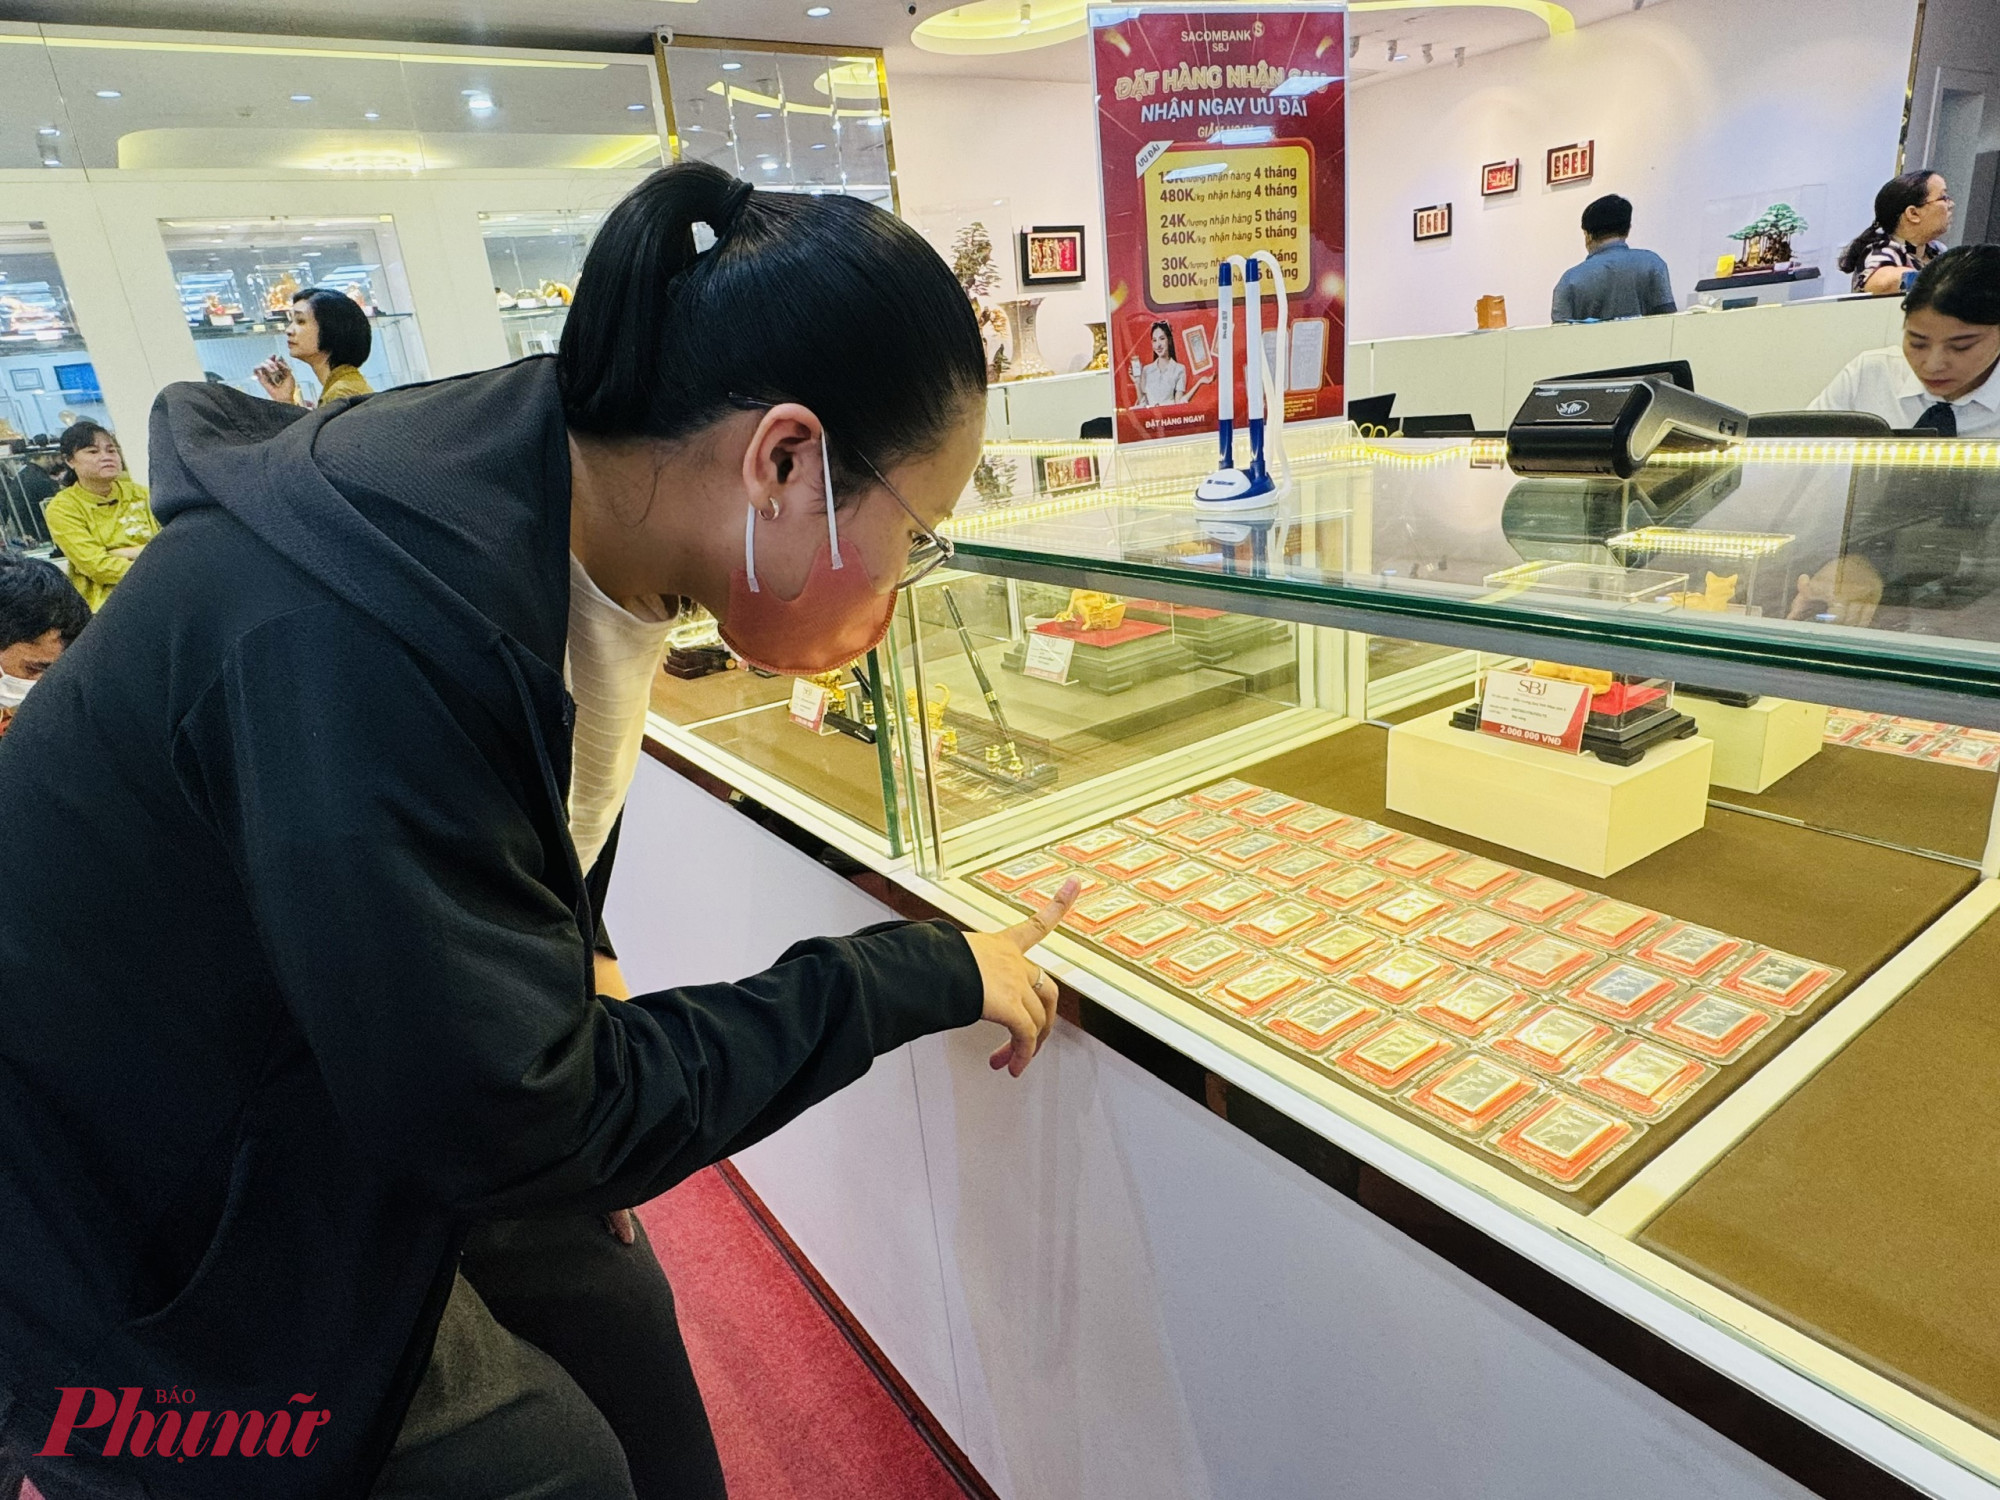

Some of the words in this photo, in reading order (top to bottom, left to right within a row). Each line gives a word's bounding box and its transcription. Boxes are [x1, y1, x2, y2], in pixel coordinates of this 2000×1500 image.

[1181, 29, 1252, 42] SACOMBANK
[1212, 42, 1230, 52] SBJ
[1115, 68, 1159, 101] ĐẶT
[1162, 61, 1223, 94] HÀNG
[1226, 59, 1285, 93] NHẬN
[1141, 97, 1194, 123] NHẬN
[1198, 97, 1246, 116] NGAY
[1249, 96, 1275, 115] ƯU
[1278, 95, 1308, 117] ĐÃI
[1254, 167, 1261, 179] 4
[1264, 164, 1297, 180] tháng
[1254, 184, 1261, 197] 4
[1265, 183, 1297, 198] tháng
[1255, 209, 1262, 222] 5
[1265, 207, 1297, 223] tháng
[1255, 227, 1262, 239] 5
[1265, 225, 1297, 240] tháng
[1160, 416, 1182, 427] HÀNG
[1182, 414, 1205, 424] NGAY!
[1518, 680, 1547, 696] SBJ
[1500, 724, 1540, 741] 2.000.000
